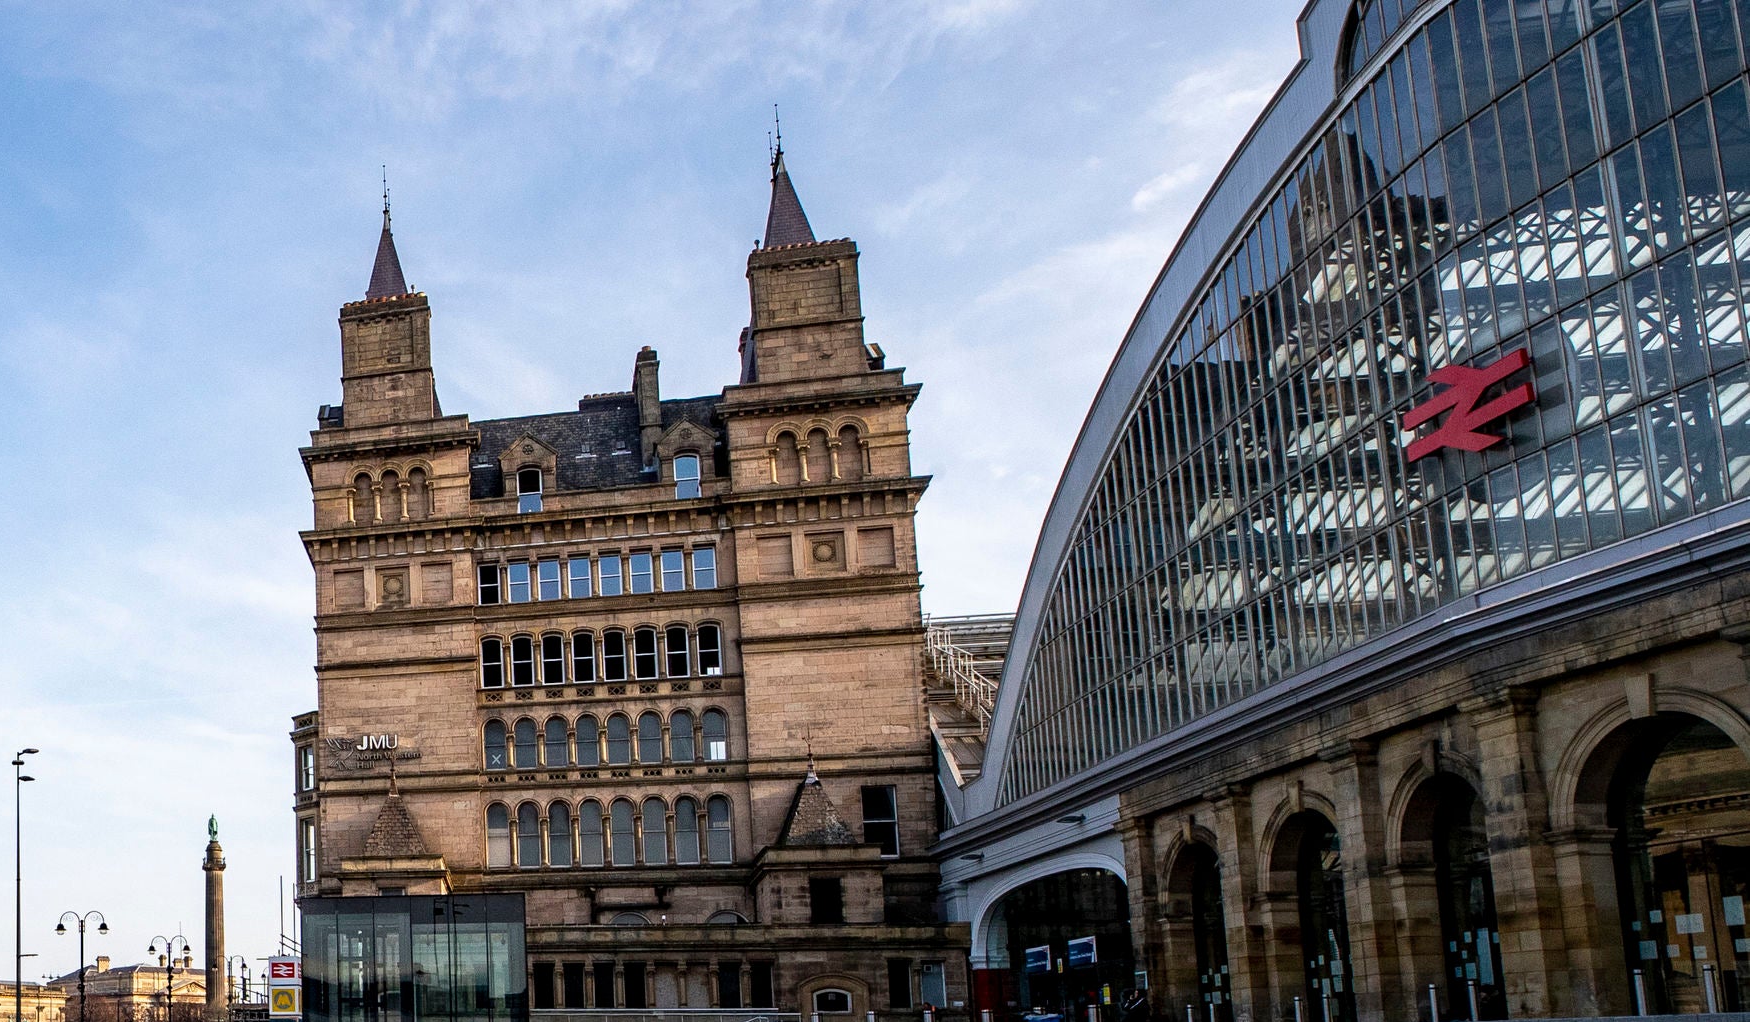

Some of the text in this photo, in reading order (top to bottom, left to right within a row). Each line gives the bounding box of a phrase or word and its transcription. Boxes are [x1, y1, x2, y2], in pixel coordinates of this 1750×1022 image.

[356, 734, 397, 751] JMU
[356, 752, 383, 761] North
[356, 761, 376, 769] Hall
